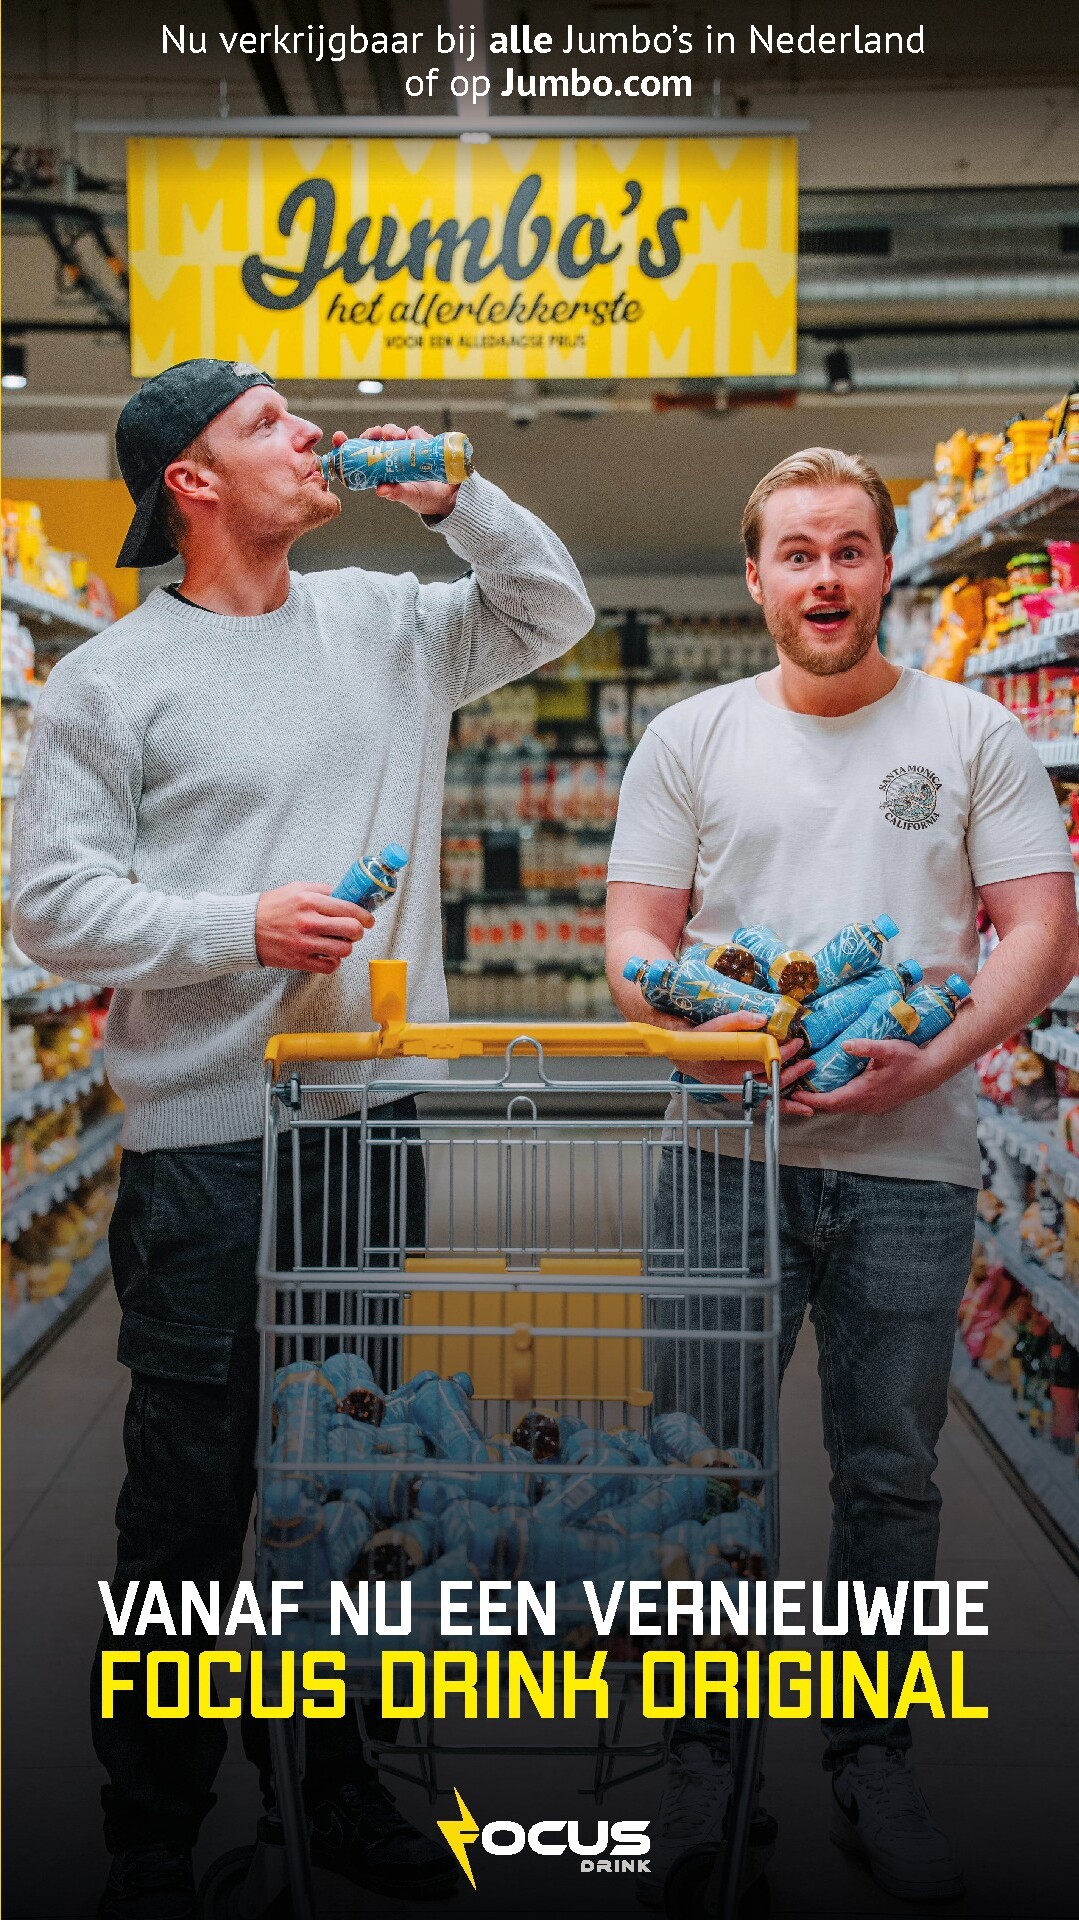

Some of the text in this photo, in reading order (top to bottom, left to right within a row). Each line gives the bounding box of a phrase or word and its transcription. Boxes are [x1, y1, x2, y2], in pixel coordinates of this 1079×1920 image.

[241, 174, 688, 311] Jumbo’s
[326, 290, 644, 327] het allerlekkerste
[384, 335, 424, 349] VOOR
[879, 765, 942, 791] SANTA MONICA
[884, 811, 940, 830] CALIFORNIA
